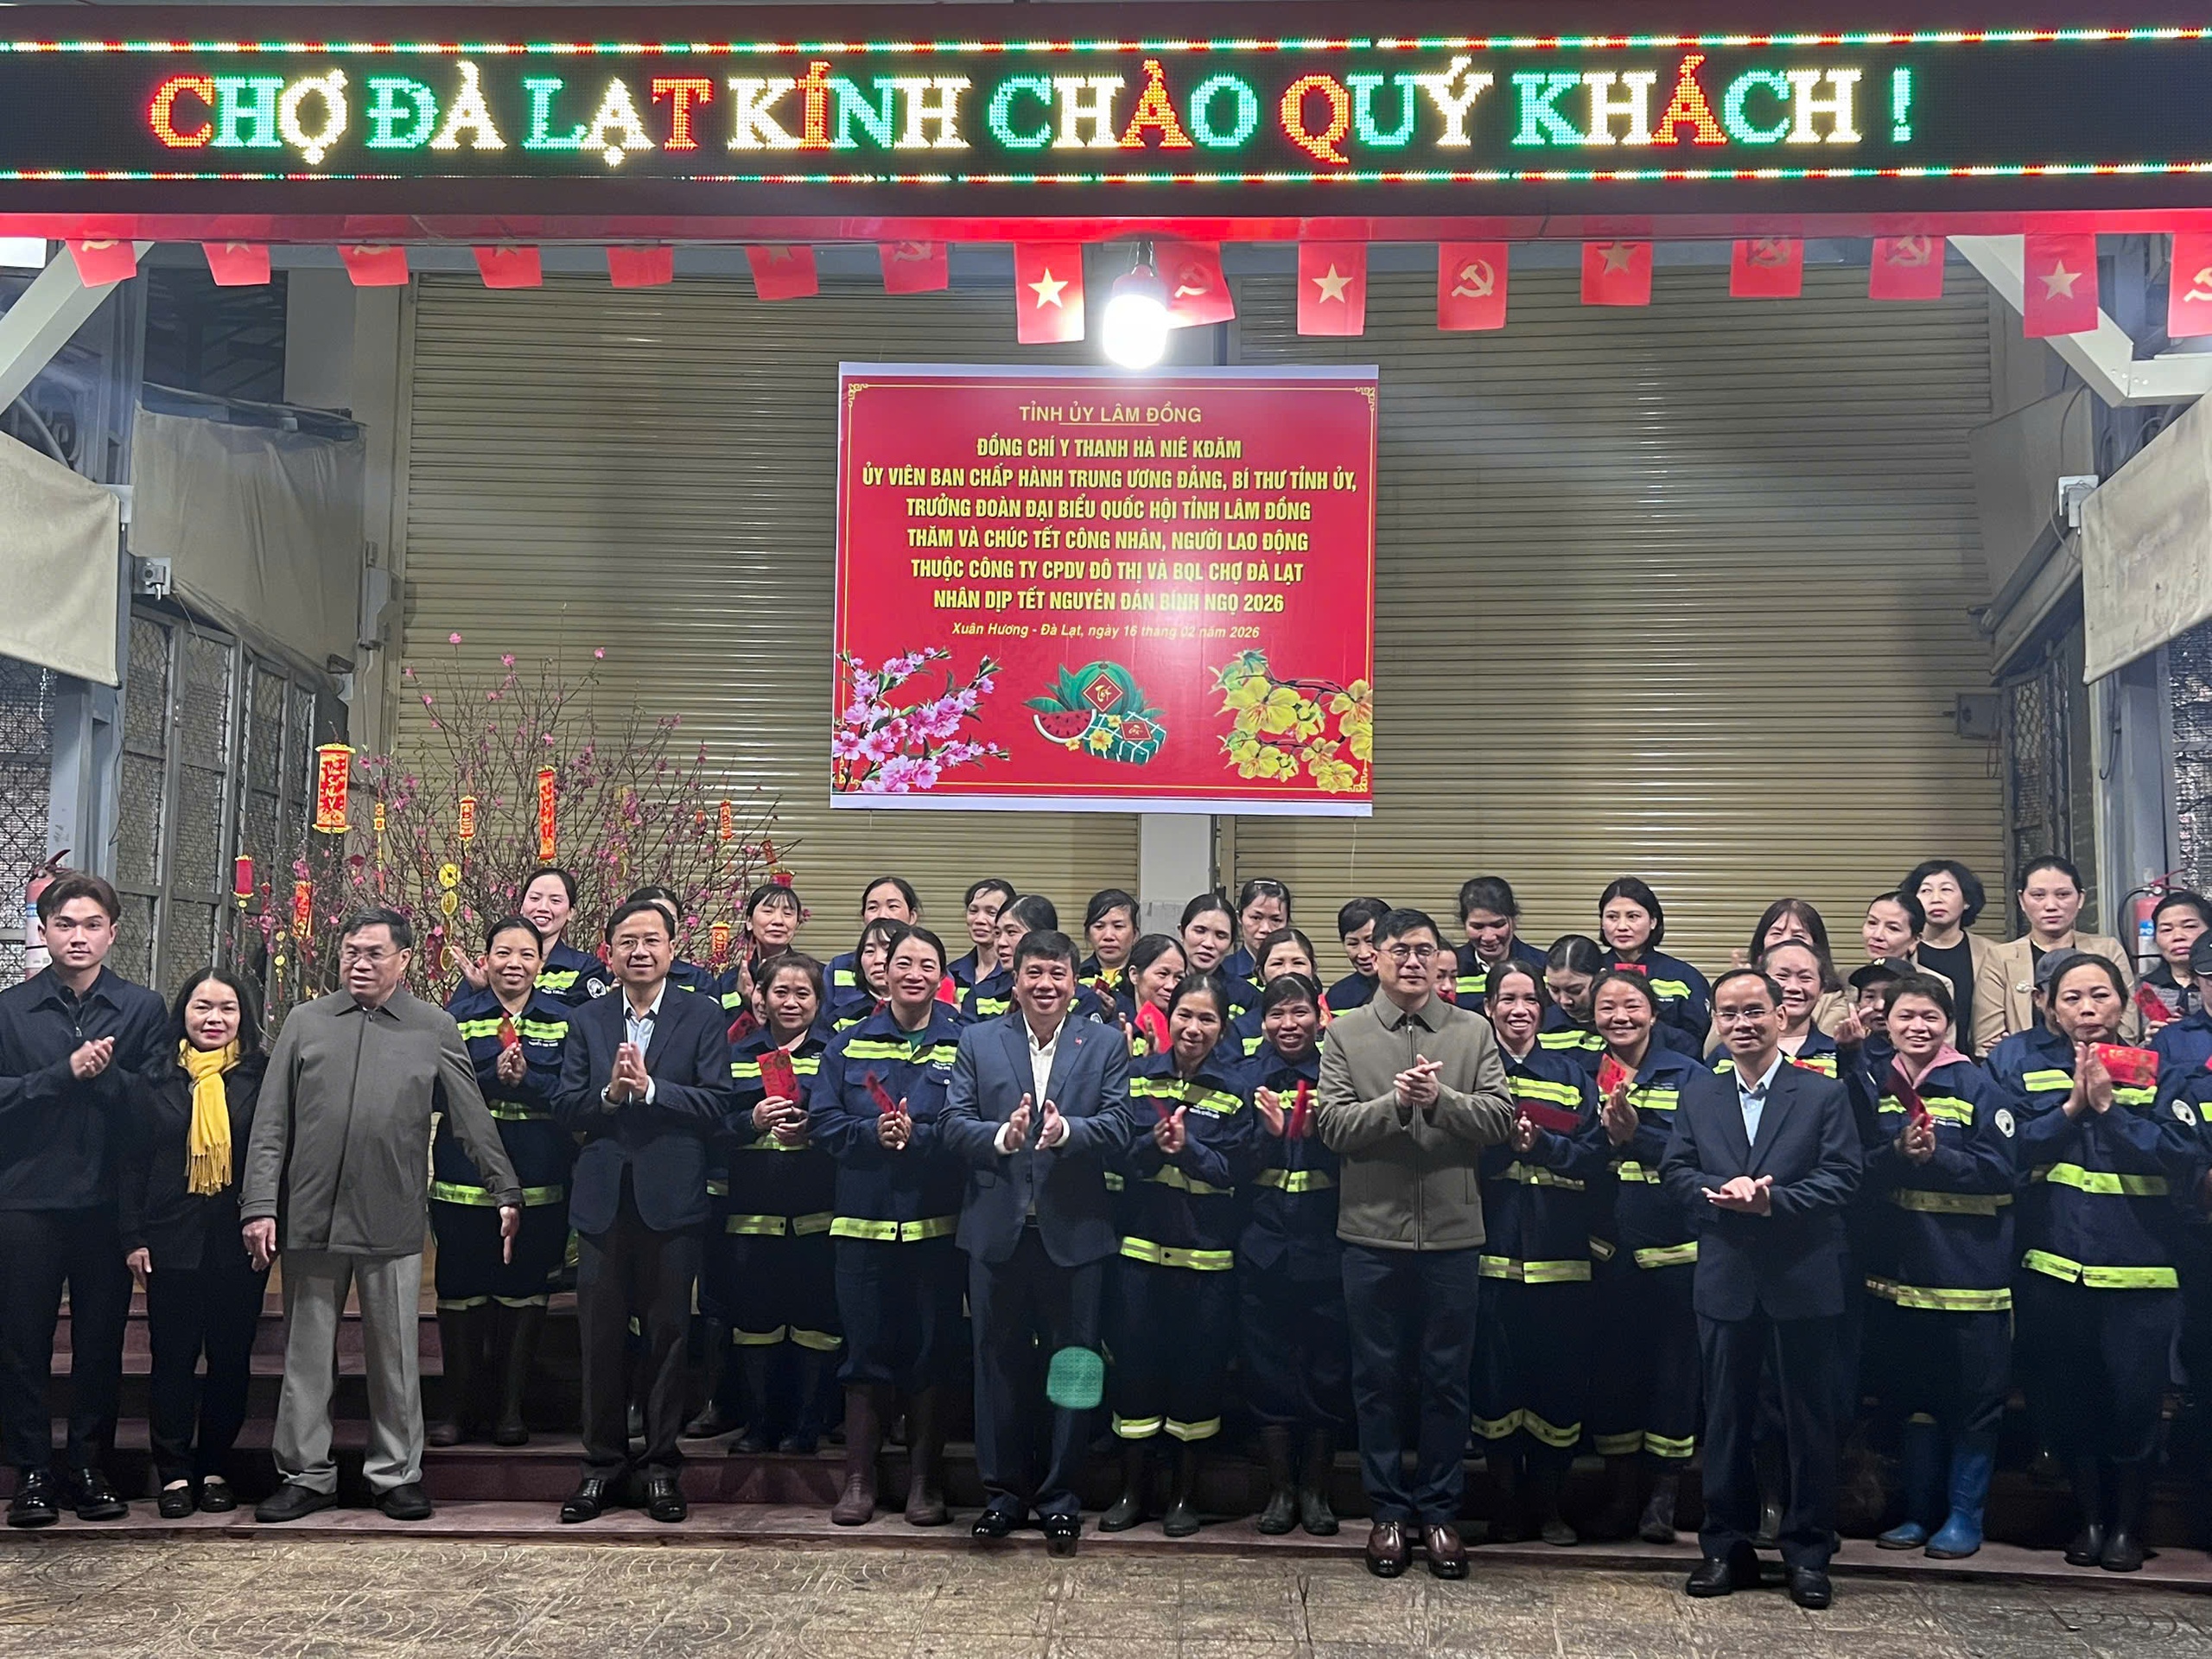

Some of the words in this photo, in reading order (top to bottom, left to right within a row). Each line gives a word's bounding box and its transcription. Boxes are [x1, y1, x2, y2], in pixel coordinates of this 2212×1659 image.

[148, 68, 348, 165] CHỢ
[366, 60, 505, 150] ĐÀ
[524, 77, 713, 167] LẠT
[728, 61, 972, 149] KÍNH
[988, 60, 1258, 149] CHÀO
[1280, 55, 1493, 164] QUÝ
[1511, 54, 1861, 145] KHÁCH
[1893, 68, 1911, 143] !
[1020, 401, 1062, 422] TỈNH
[1069, 401, 1093, 422] ỦY
[1102, 403, 1139, 423] LÂM
[1147, 401, 1201, 423] ĐỒNG
[977, 433, 1022, 456] ĐỒNG
[1027, 435, 1054, 456] CHÍ
[1059, 439, 1070, 456] Y
[1075, 439, 1128, 457] THANH
[1134, 435, 1154, 457] HÀ
[1160, 436, 1187, 458] NIÊ
[1193, 437, 1242, 458] KĐĂM
[862, 461, 883, 485] ỦY
[888, 465, 925, 486] VIÊN
[931, 467, 964, 486] BAN
[969, 463, 1013, 486] CHẤP
[1018, 465, 1063, 487] HÀNH
[1068, 469, 1122, 487] TRUNG
[1127, 470, 1172, 488] ƯƠNG
[1177, 465, 1227, 490] ĐẢNG,
[1232, 467, 1249, 489] BÍ
[1254, 470, 1287, 489] THƯ
[1290, 466, 1328, 489] TỈNH
[1333, 466, 1357, 492] ỦY,
[906, 493, 970, 516] TRƯỞNG
[976, 497, 1020, 517] ĐOÀN
[1026, 500, 1052, 521] ĐẠI
[1058, 493, 1096, 518] BIỂU
[1101, 495, 1144, 518] QUỐC
[1150, 499, 1177, 522] HỘI
[1183, 496, 1218, 519] TỈNH
[1224, 498, 1259, 519] LÂM
[1265, 496, 1311, 519] ĐỒNG
[907, 525, 953, 547] THĂM
[958, 526, 979, 547] VÀ
[984, 527, 1027, 548] CHÚC
[1033, 524, 1060, 548] TẾT
[1065, 527, 1110, 549] CÔNG
[1116, 528, 1166, 551] NHÂN,
[1172, 529, 1222, 550] NGƯỜI
[1228, 532, 1257, 550] LAO
[1262, 529, 1308, 554] ĐỘNG
[912, 556, 963, 582] THUỘC
[969, 556, 1014, 578] CÔNG
[1019, 561, 1038, 579] TY
[1042, 562, 1085, 579] CPDV
[1090, 558, 1112, 580] ĐÔ
[1116, 562, 1141, 583] THỊ
[1147, 559, 1167, 580] VÀ
[1173, 563, 1204, 582] BQL
[1209, 562, 1243, 584] CHỢ
[1247, 560, 1269, 582] ĐÀ
[1274, 563, 1303, 585] LẠT
[934, 588, 980, 608] NHÂN
[985, 592, 1013, 613] DỊP
[1018, 587, 1045, 609] TẾT
[1050, 588, 1116, 610] NGUYÊN
[1205, 594, 1238, 615] NGỌ
[1243, 594, 1284, 612] 2026
[952, 622, 983, 635] Xuân
[988, 622, 1028, 639] Hương
[1040, 623, 1058, 636] Đà
[1061, 625, 1084, 638] Lạt,
[1088, 625, 1118, 639] ngày
[1123, 626, 1137, 637] 16
[1230, 626, 1260, 639] 2026
